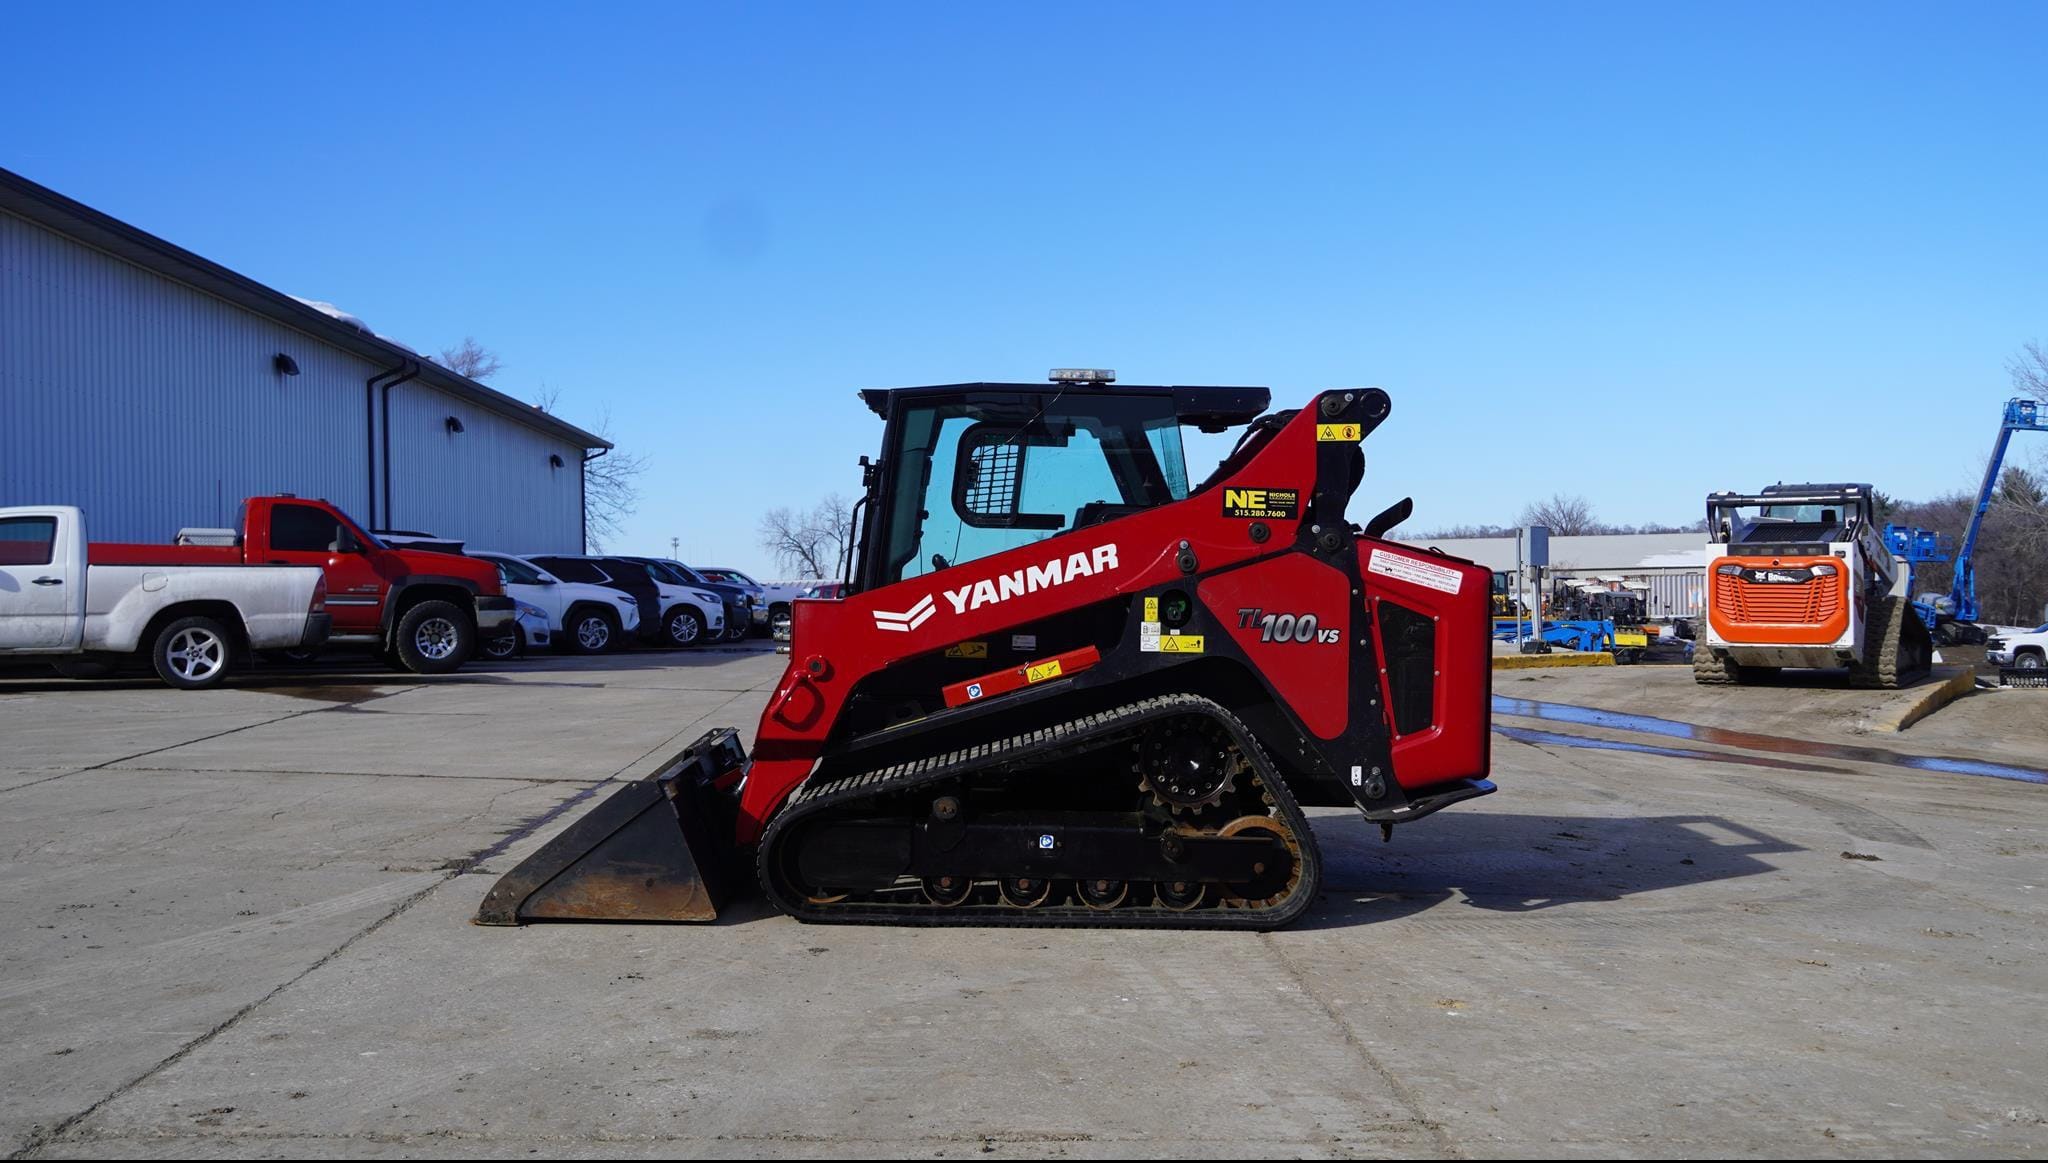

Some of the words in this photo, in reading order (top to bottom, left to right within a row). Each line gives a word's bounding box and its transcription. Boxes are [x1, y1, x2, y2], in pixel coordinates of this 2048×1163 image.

[1225, 490, 1266, 508] NE
[1380, 552, 1409, 564] CUSTOMER
[943, 543, 1119, 614] YANMAR
